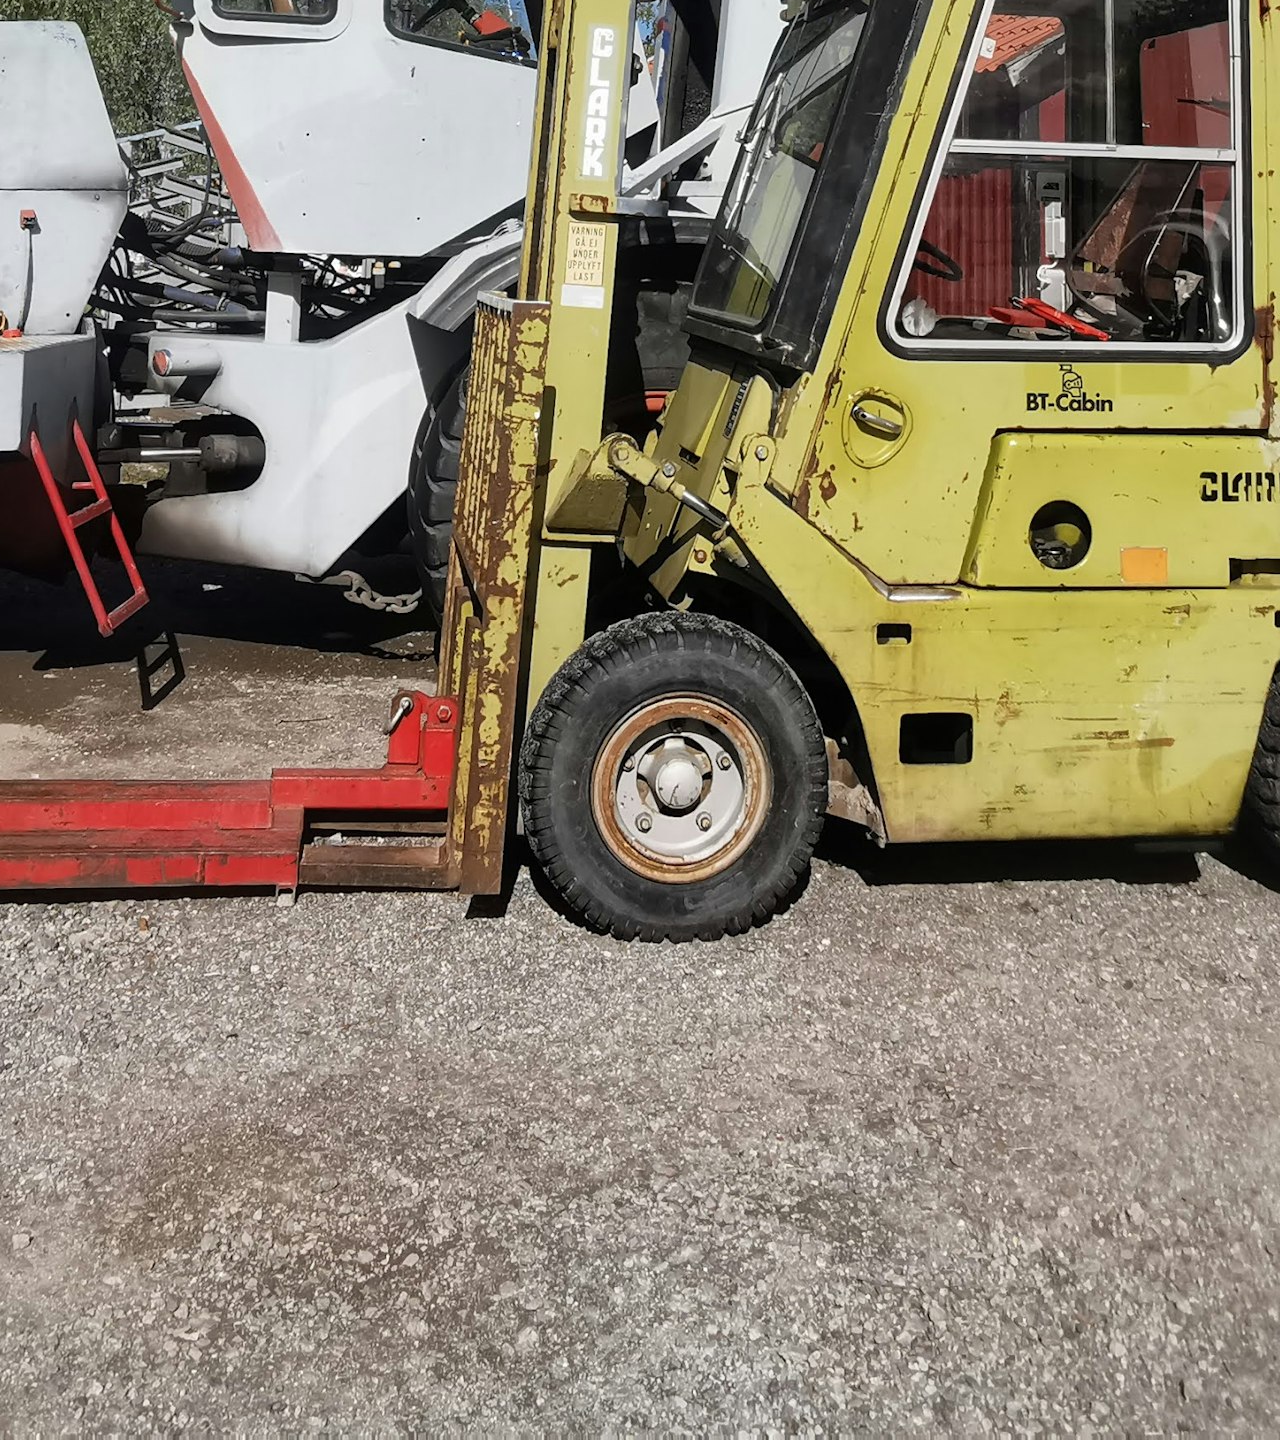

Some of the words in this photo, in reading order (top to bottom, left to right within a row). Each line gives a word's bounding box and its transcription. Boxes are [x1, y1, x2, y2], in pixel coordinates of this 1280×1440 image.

[582, 27, 614, 177] CLARK
[571, 226, 604, 237] VARNING
[575, 237, 586, 247] GÅ
[589, 238, 598, 248] EJ
[573, 249, 599, 259] UNDER
[567, 260, 602, 271] UPPLYFT
[573, 272, 595, 282] LAST
[1026, 392, 1114, 412] BT-Cabin
